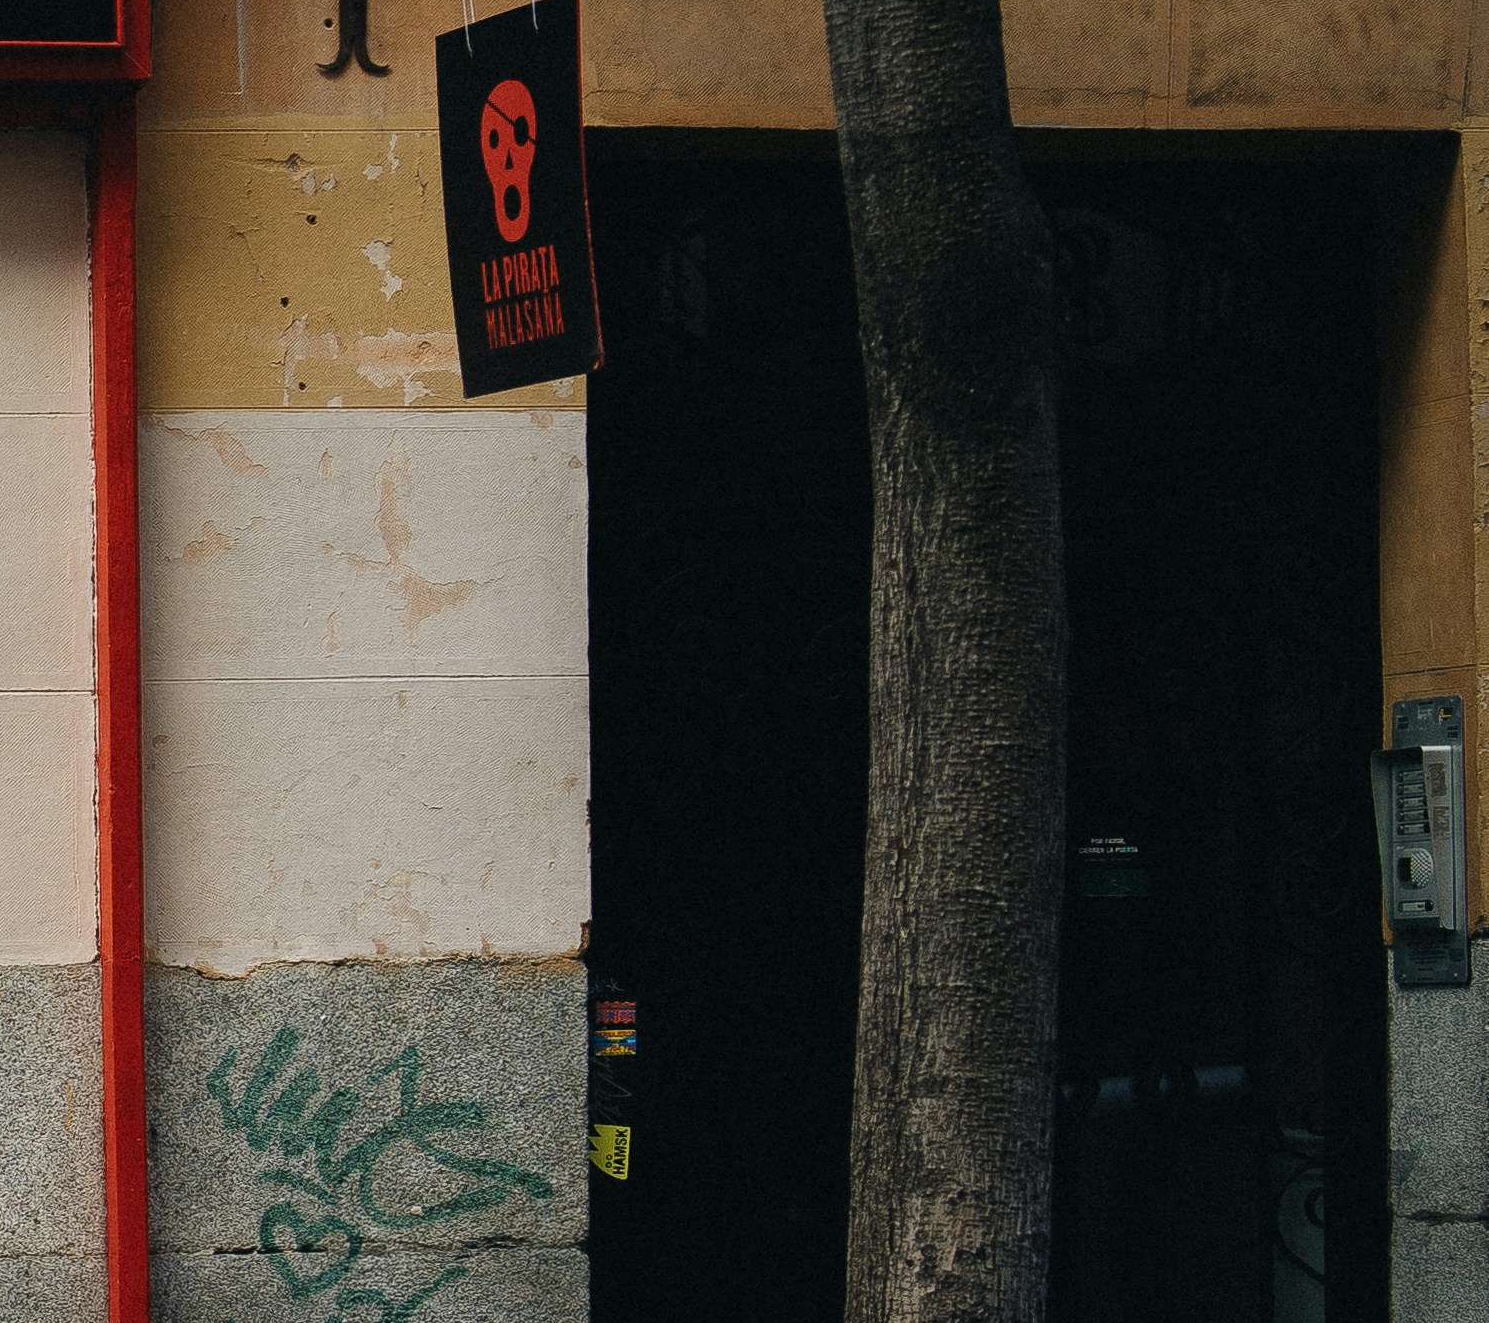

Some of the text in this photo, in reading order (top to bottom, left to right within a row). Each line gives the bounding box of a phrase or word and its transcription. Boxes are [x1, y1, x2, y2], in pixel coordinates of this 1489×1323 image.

[480, 243, 560, 304] LA PIRATA
[612, 1128, 629, 1175] HAMSK
